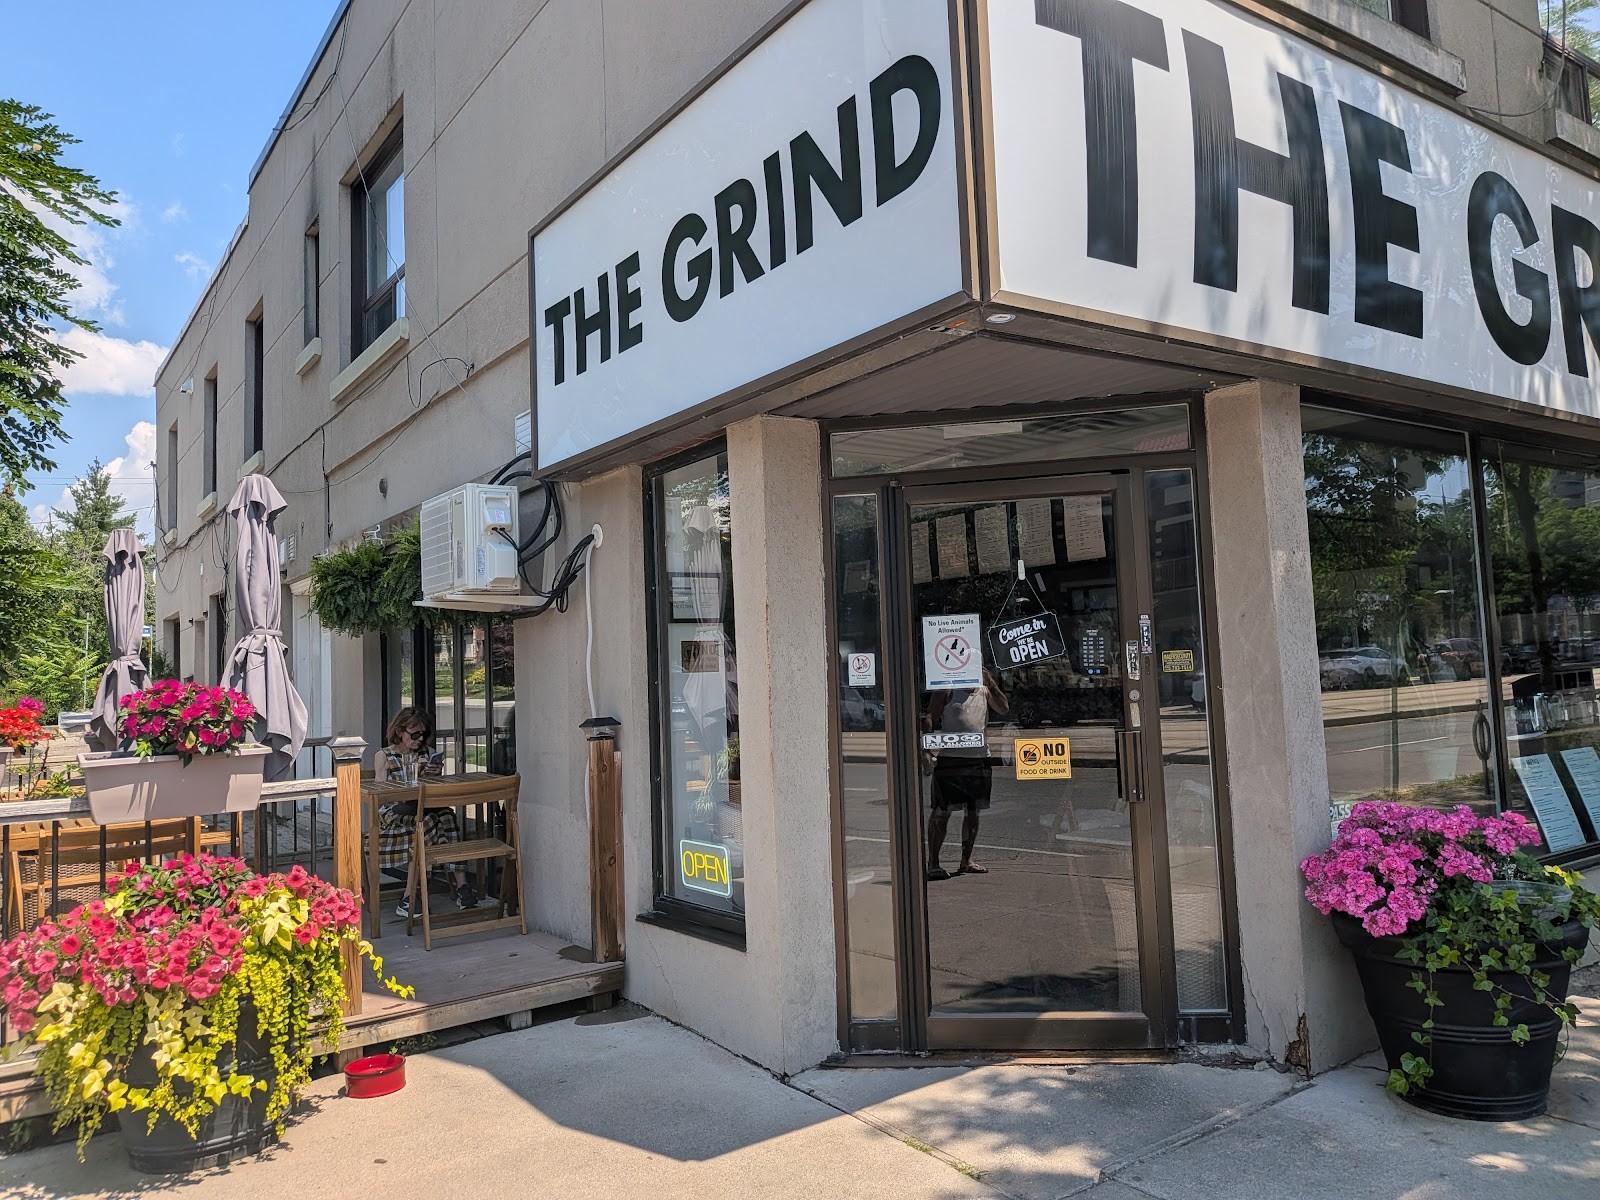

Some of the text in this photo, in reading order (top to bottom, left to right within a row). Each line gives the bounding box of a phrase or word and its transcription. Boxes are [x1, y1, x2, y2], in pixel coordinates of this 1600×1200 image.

[1034, 0, 1424, 339] THE
[544, 54, 942, 387] THE GRIND
[950, 618, 974, 626] Animals
[998, 618, 1047, 645] Come in
[1009, 639, 1050, 663] OPEN
[1017, 636, 1034, 646] WE'RE
[926, 735, 960, 743] NO
[1043, 743, 1066, 757] NO
[683, 850, 728, 885] OPEN
